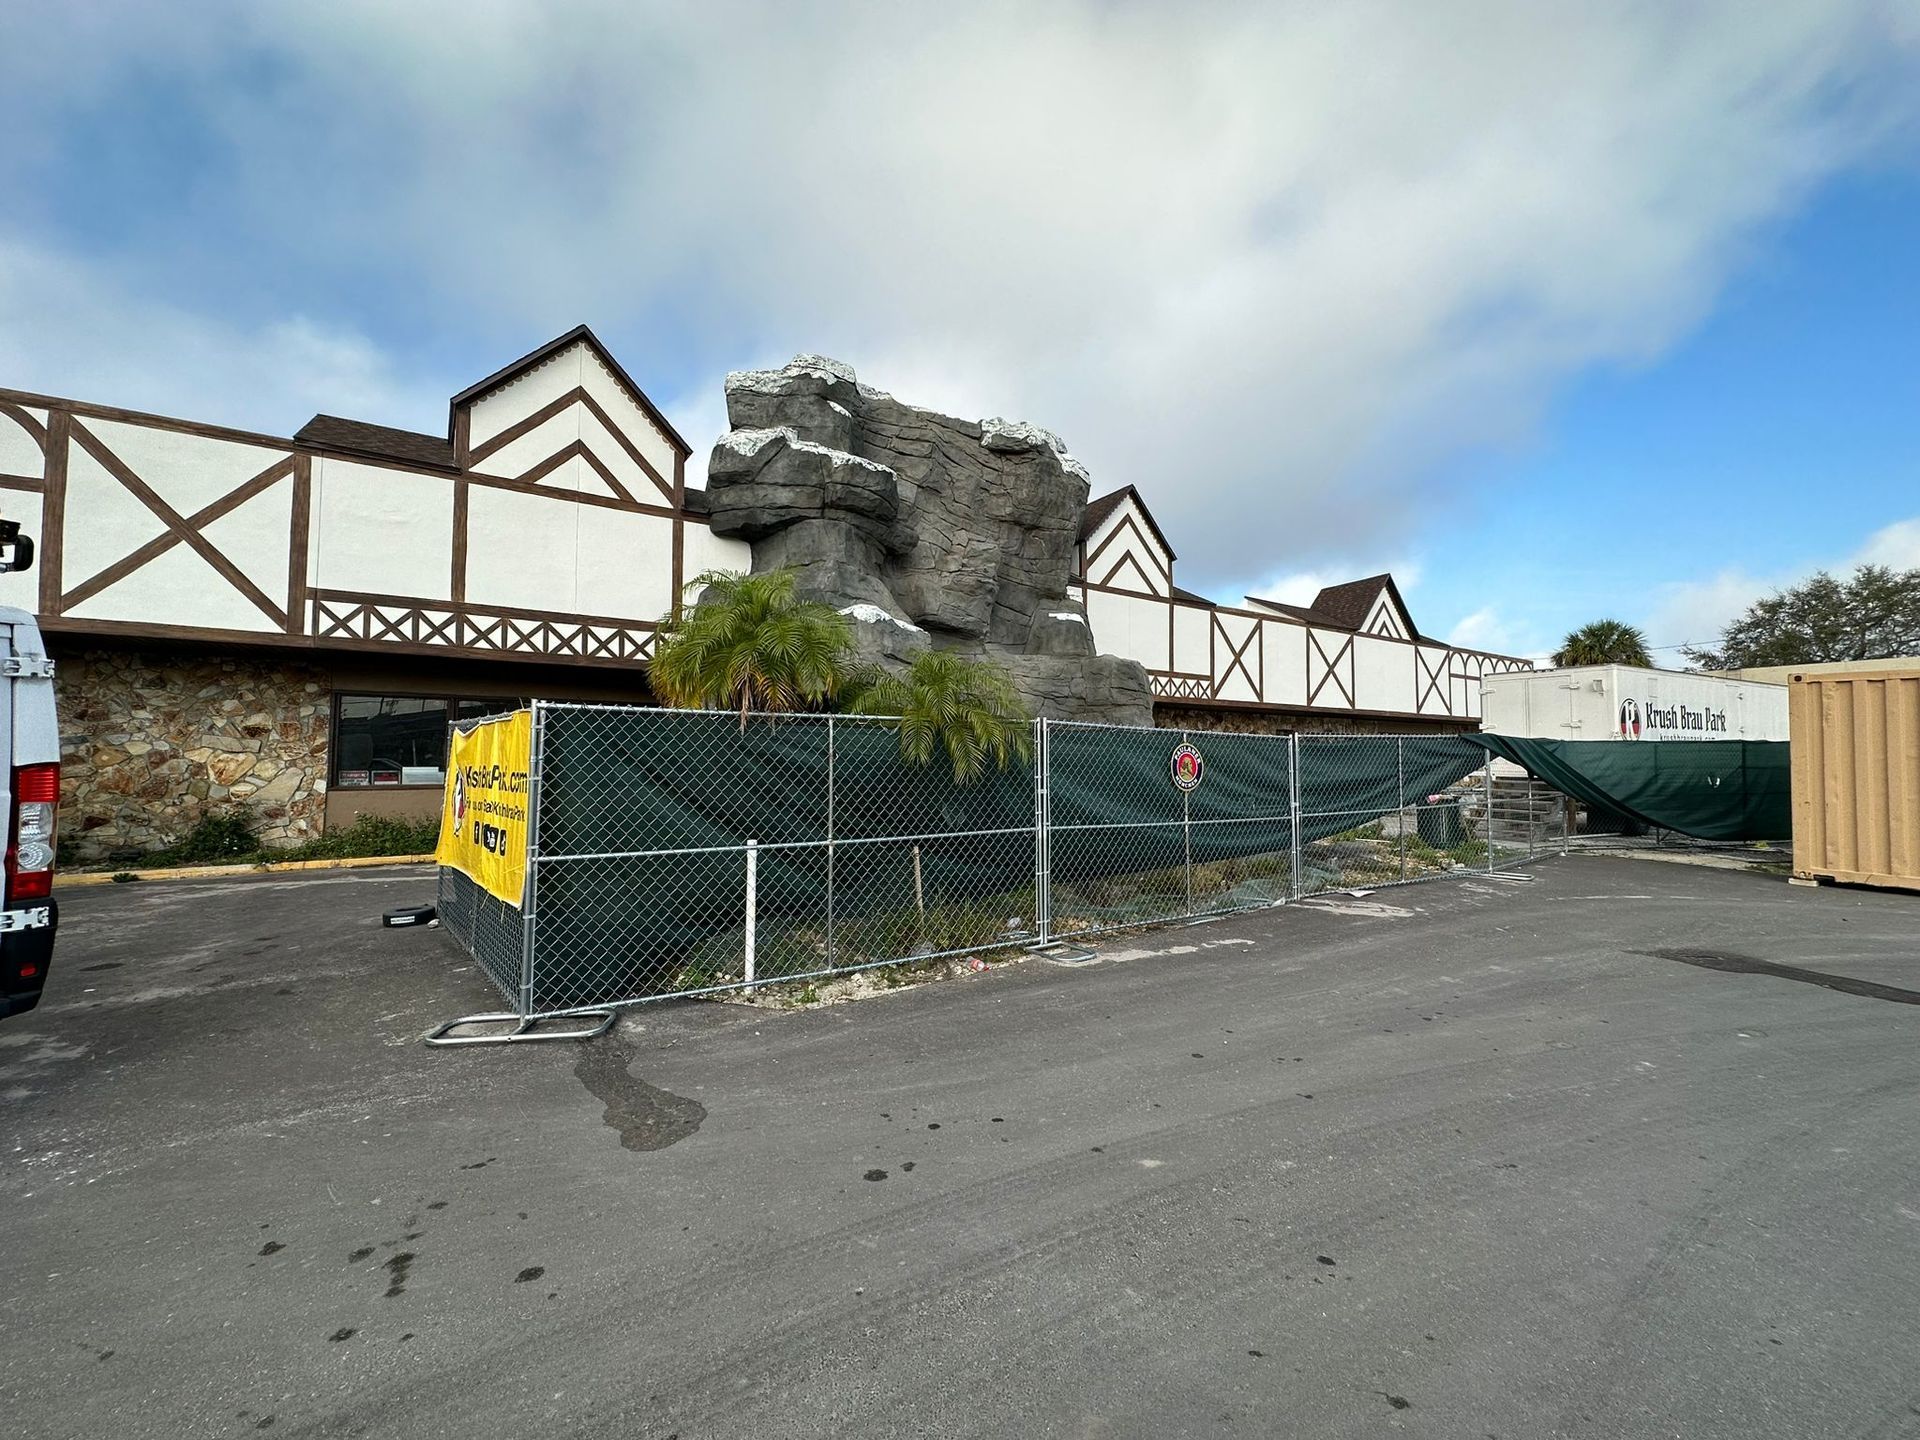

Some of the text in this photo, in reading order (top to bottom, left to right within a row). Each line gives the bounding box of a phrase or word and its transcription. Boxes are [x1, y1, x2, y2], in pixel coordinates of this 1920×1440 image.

[1645, 702, 1727, 732] Krush Brau Park
[1174, 746, 1201, 764] PAULANER
